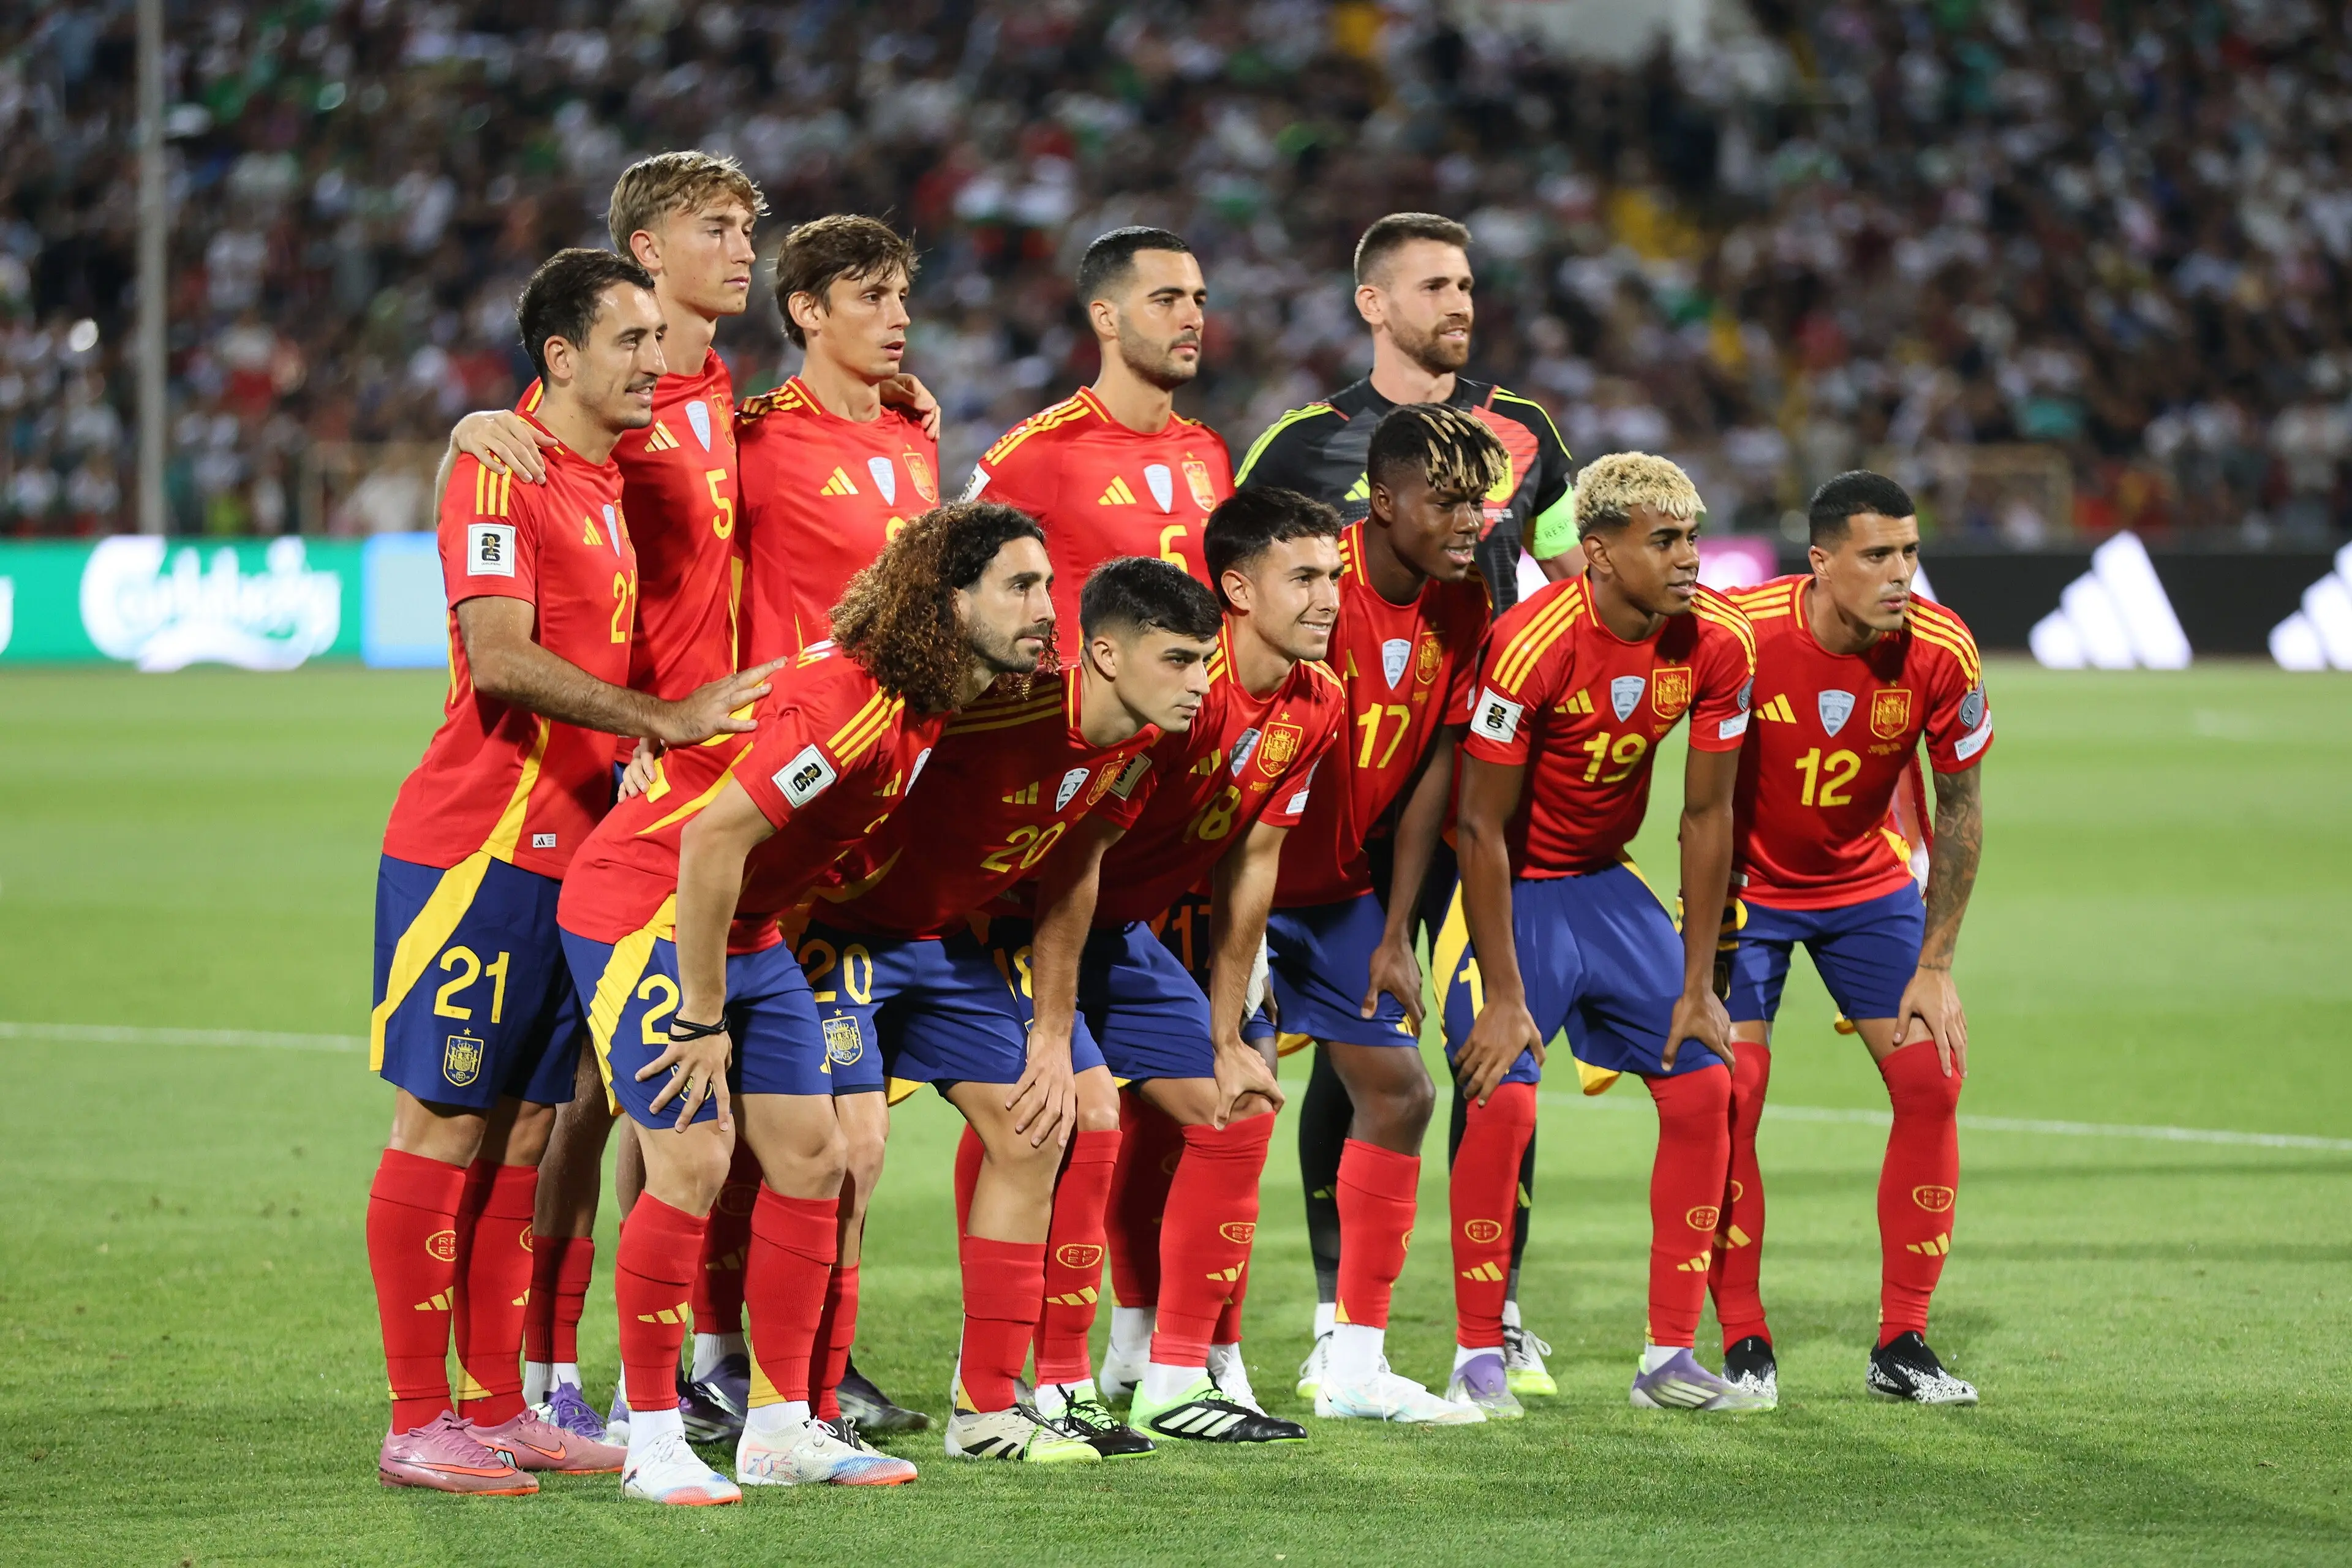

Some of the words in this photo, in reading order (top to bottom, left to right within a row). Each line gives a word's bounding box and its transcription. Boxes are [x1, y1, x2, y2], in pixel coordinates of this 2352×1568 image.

[705, 468, 733, 540] 5
[1159, 524, 1189, 574] 6
[610, 569, 637, 644] 21
[1357, 703, 1411, 769] 17
[1583, 731, 1648, 783] 19
[1795, 747, 1861, 807] 12
[1182, 784, 1242, 845] 18
[980, 821, 1066, 873] 20
[434, 945, 510, 1024] 21
[797, 938, 874, 1005] 20
